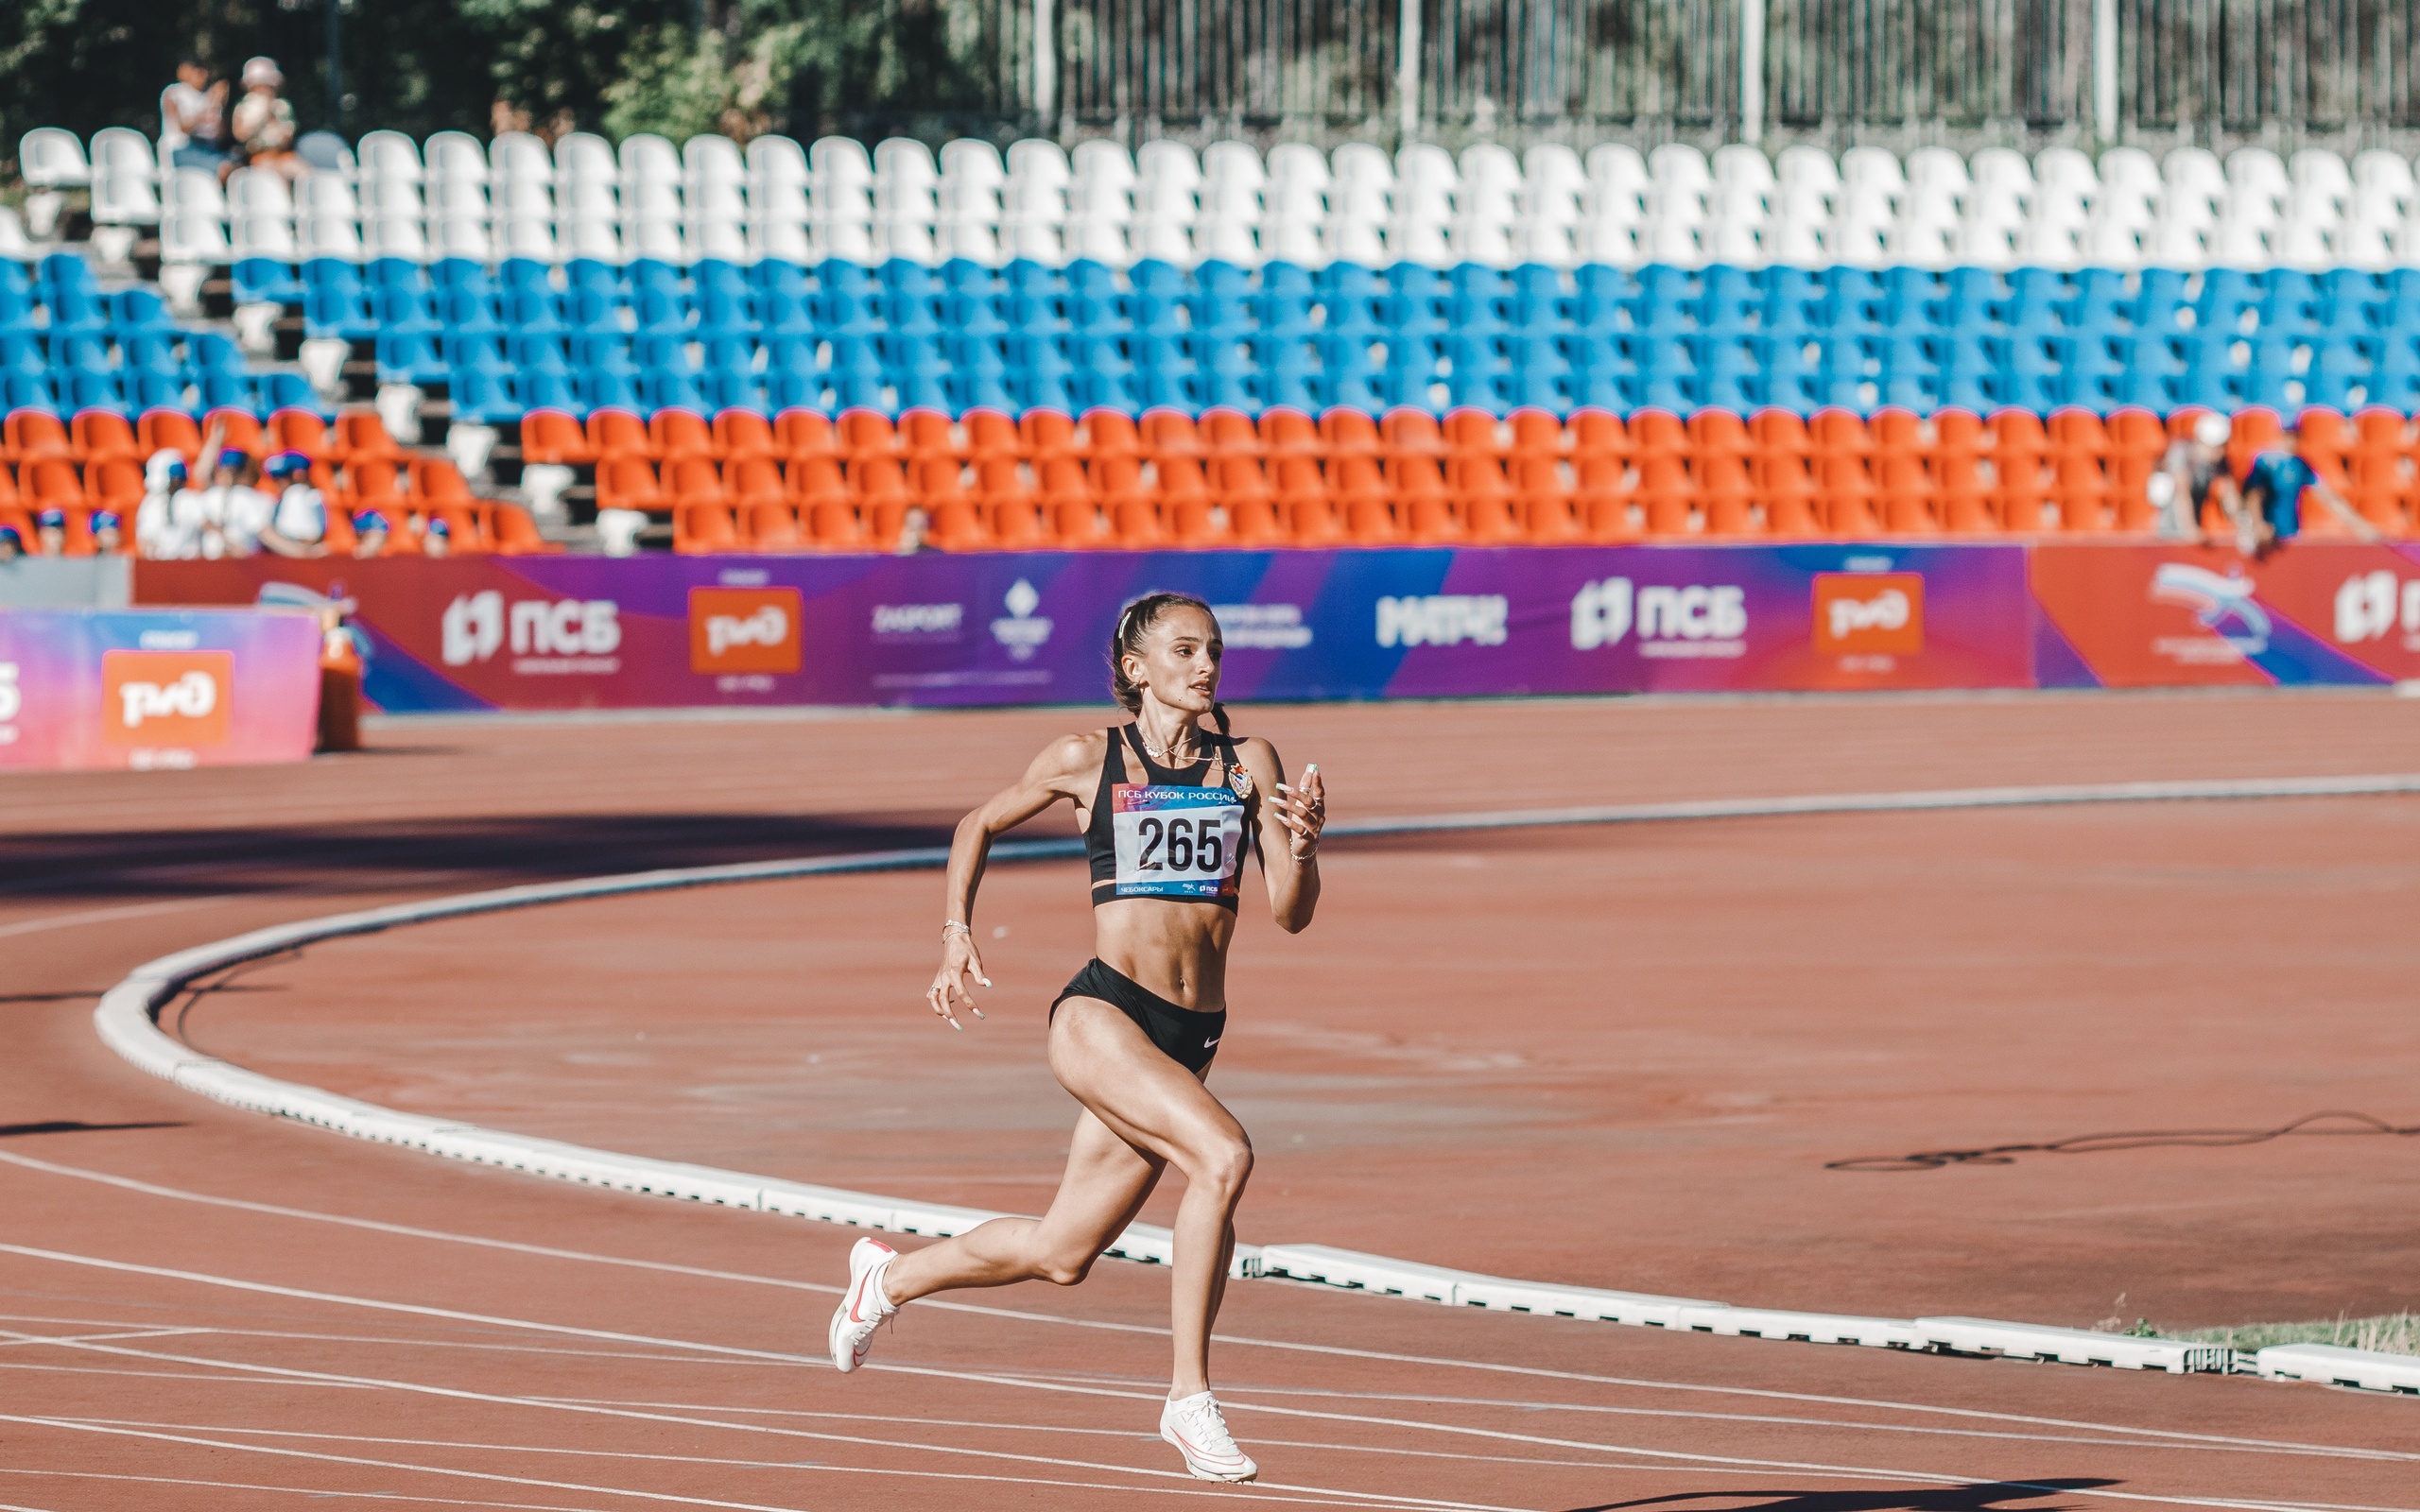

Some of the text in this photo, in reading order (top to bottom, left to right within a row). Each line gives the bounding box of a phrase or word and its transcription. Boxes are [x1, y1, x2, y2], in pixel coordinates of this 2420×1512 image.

[510, 600, 621, 654] ПСБ
[1636, 584, 1748, 639] ПСБ
[1117, 790, 1142, 799] ПСБ
[1144, 791, 1185, 800] КУБОК
[1138, 817, 1222, 872] 265
